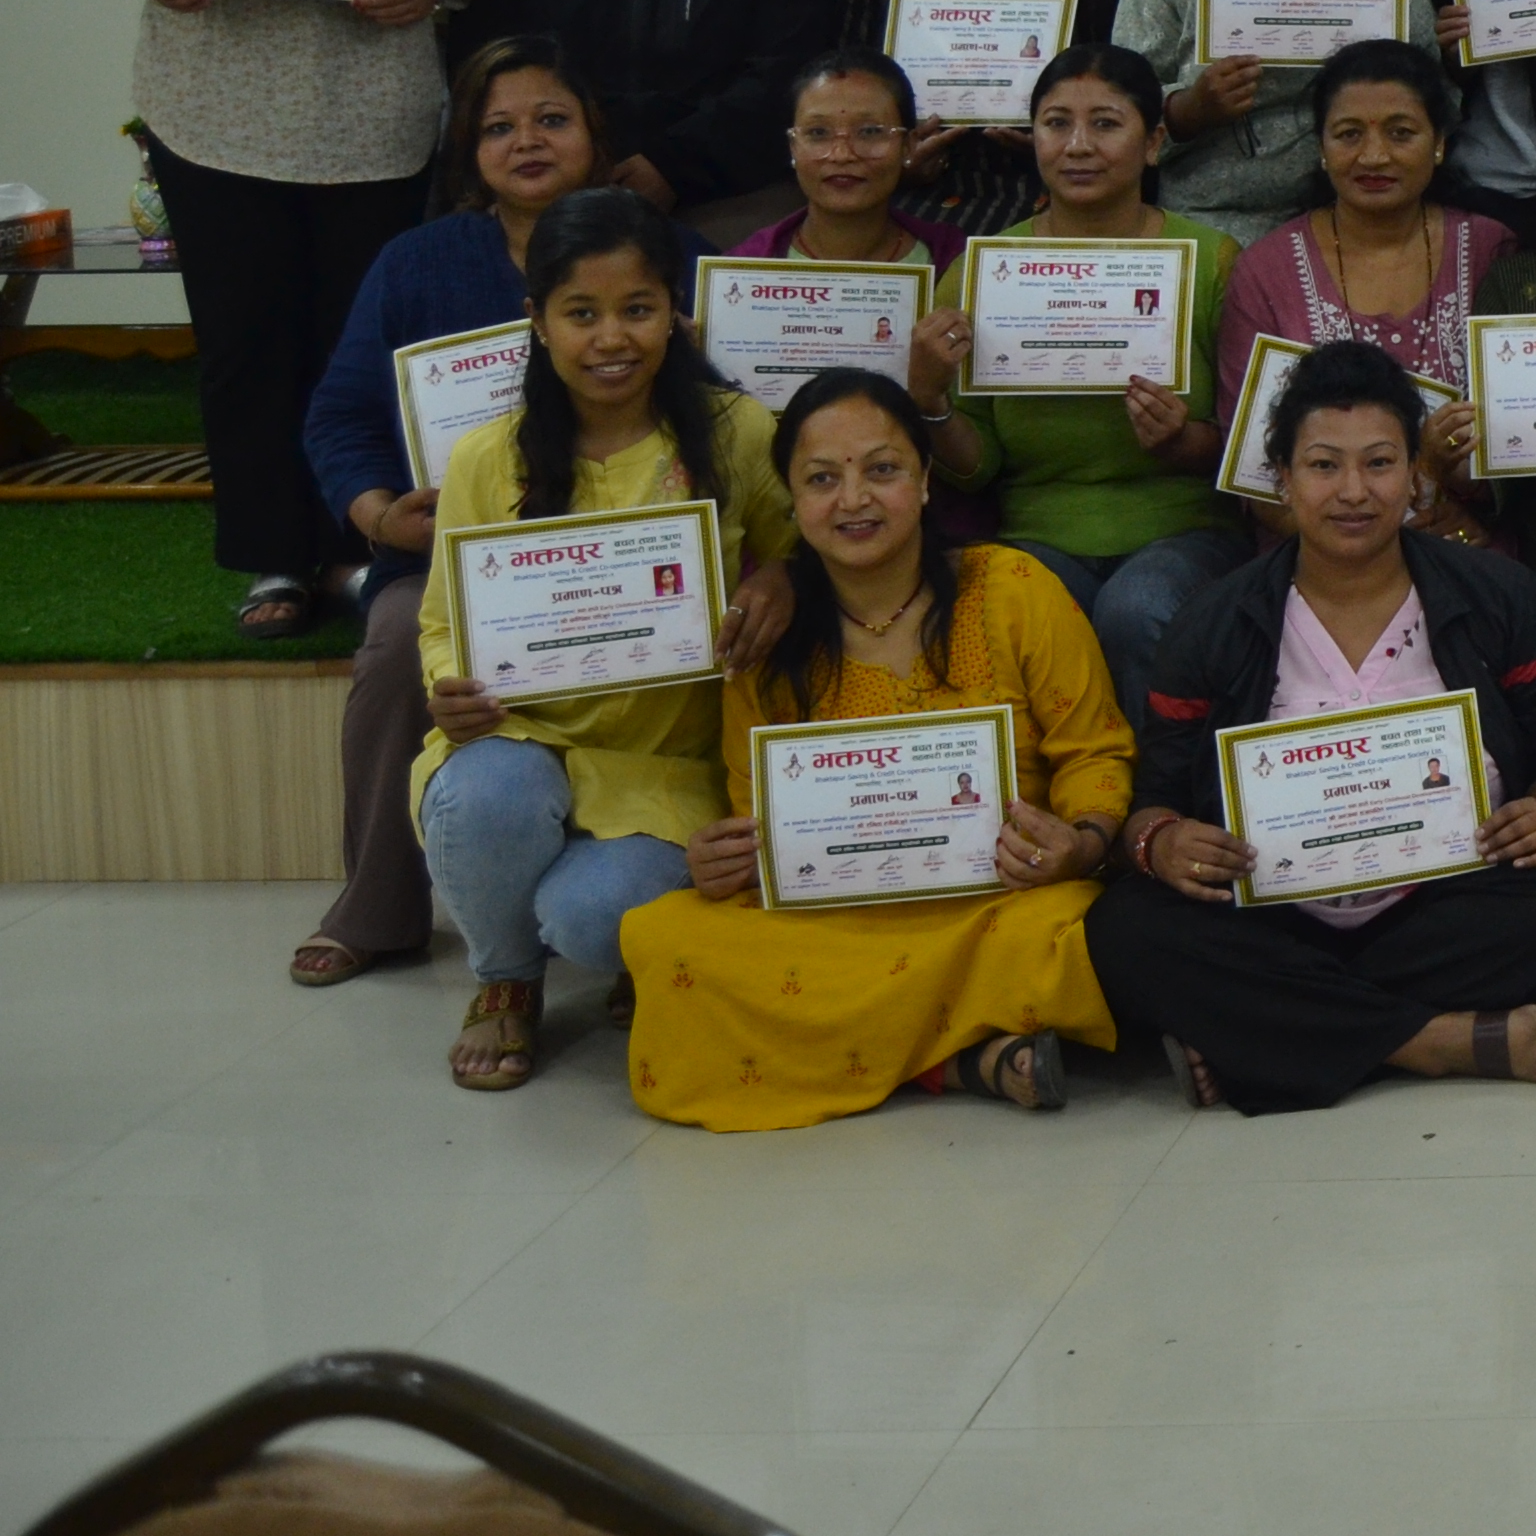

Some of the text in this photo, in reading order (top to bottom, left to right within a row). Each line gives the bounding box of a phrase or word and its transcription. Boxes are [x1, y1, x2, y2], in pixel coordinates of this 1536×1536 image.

[930, 9, 995, 25] भक्तपुर
[1019, 263, 1098, 280] भक्तपुर
[752, 285, 834, 304] भक्तपुर
[510, 542, 604, 567] भक्तपुर
[812, 746, 902, 769] भक्तपुर
[1281, 736, 1371, 765] भक्तपुर
